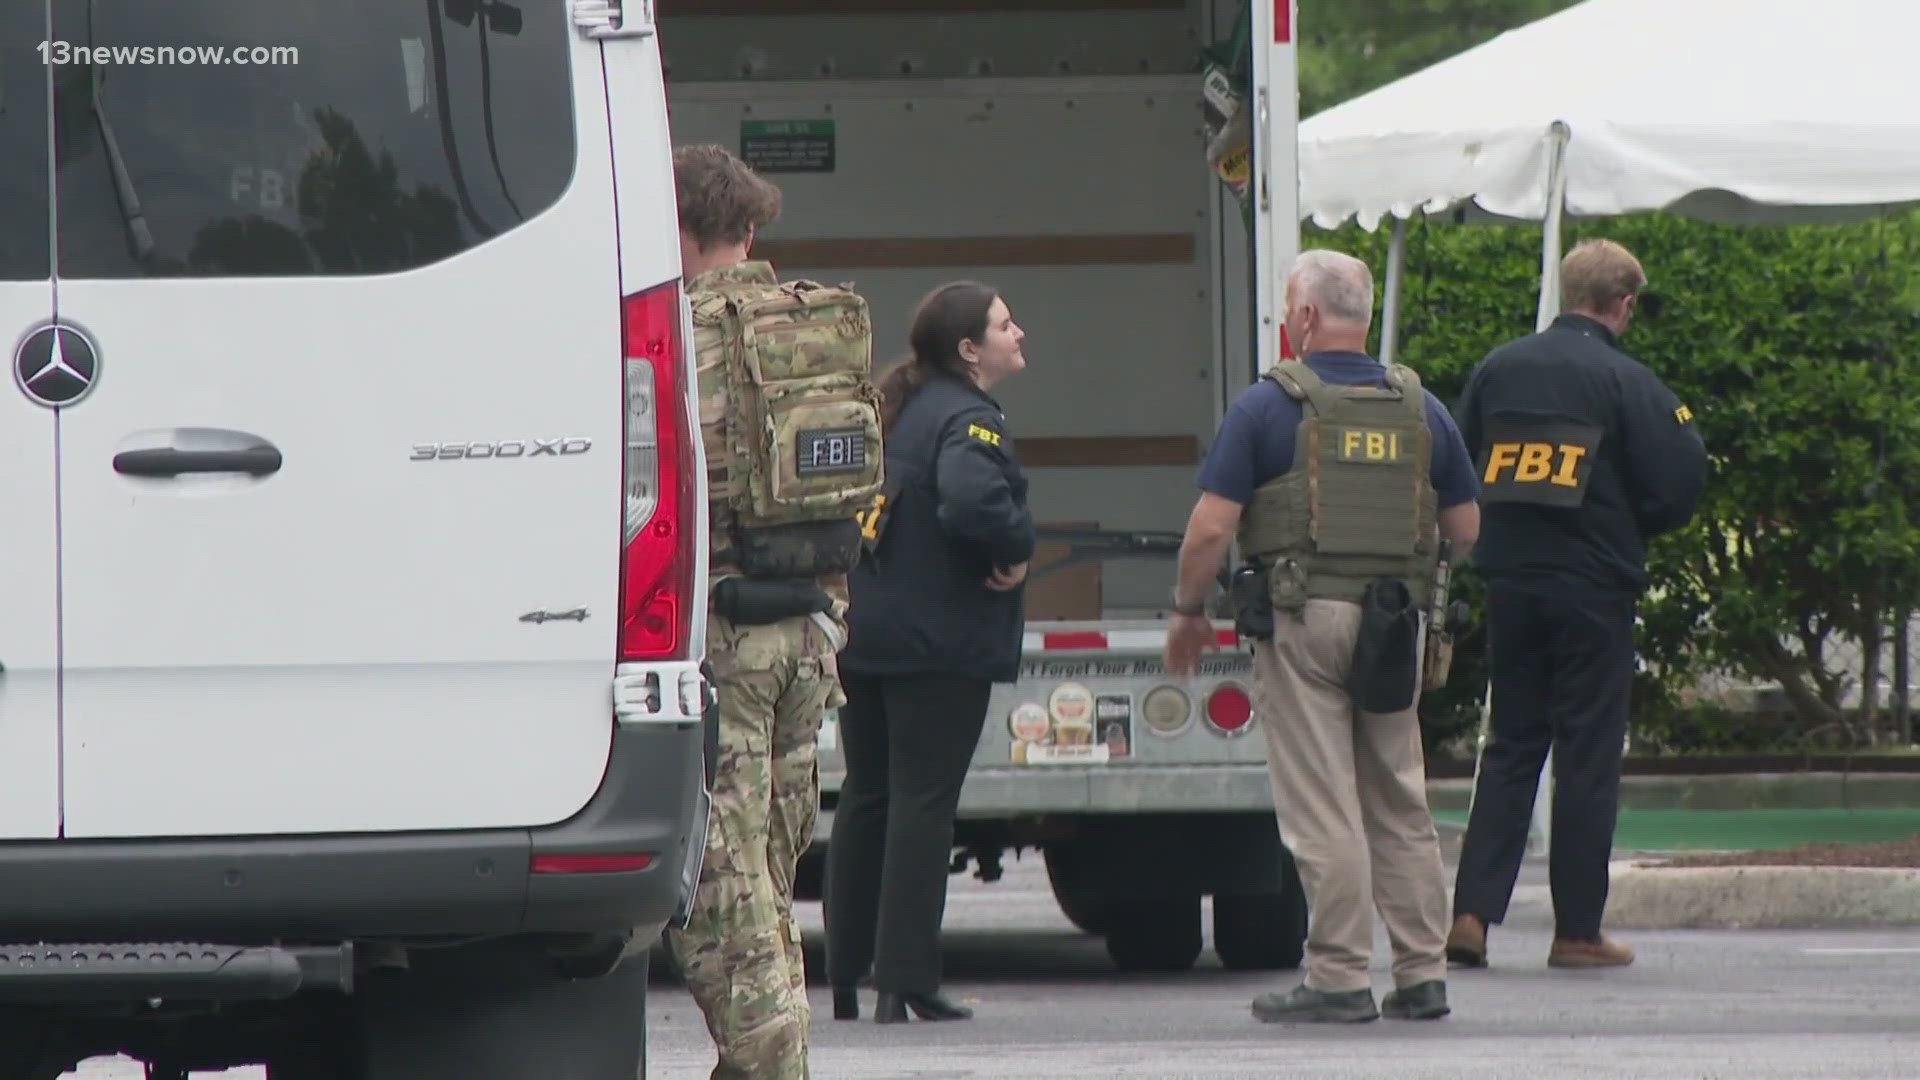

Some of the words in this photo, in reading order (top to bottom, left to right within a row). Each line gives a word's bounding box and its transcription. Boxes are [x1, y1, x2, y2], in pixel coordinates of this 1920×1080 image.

[409, 440, 525, 461] 3500
[528, 436, 592, 457] XD
[968, 424, 1000, 446] FBI
[1343, 430, 1397, 461] FBI
[812, 436, 853, 467] FBI
[1483, 442, 1586, 488] FBI
[1041, 660, 1091, 677] Forget
[1096, 660, 1128, 676] Your
